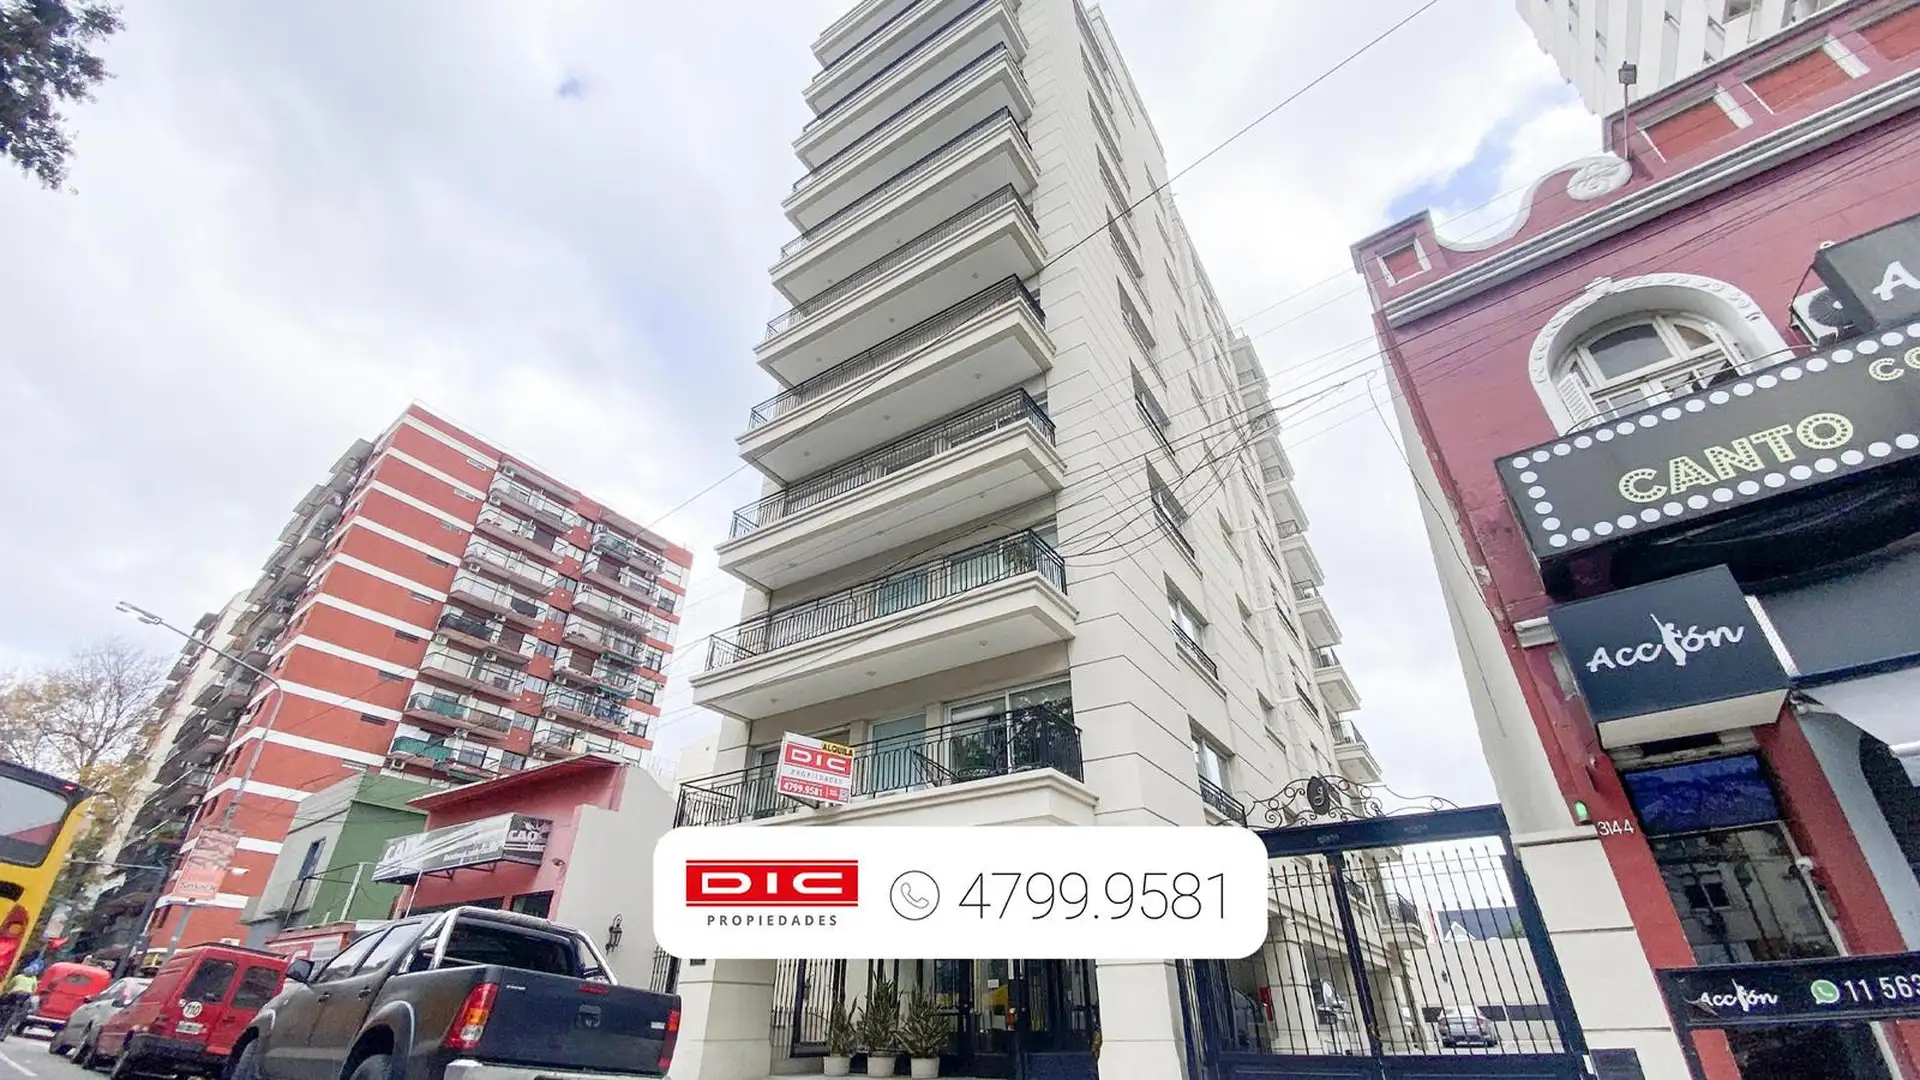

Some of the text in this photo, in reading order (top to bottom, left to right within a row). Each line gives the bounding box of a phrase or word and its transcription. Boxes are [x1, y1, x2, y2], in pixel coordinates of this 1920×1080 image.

[1618, 412, 1854, 504] CANTO
[791, 748, 847, 772] DIC
[823, 743, 853, 757] ALQUILA
[1597, 818, 1634, 836] 3144
[1844, 979, 1873, 1002] 11
